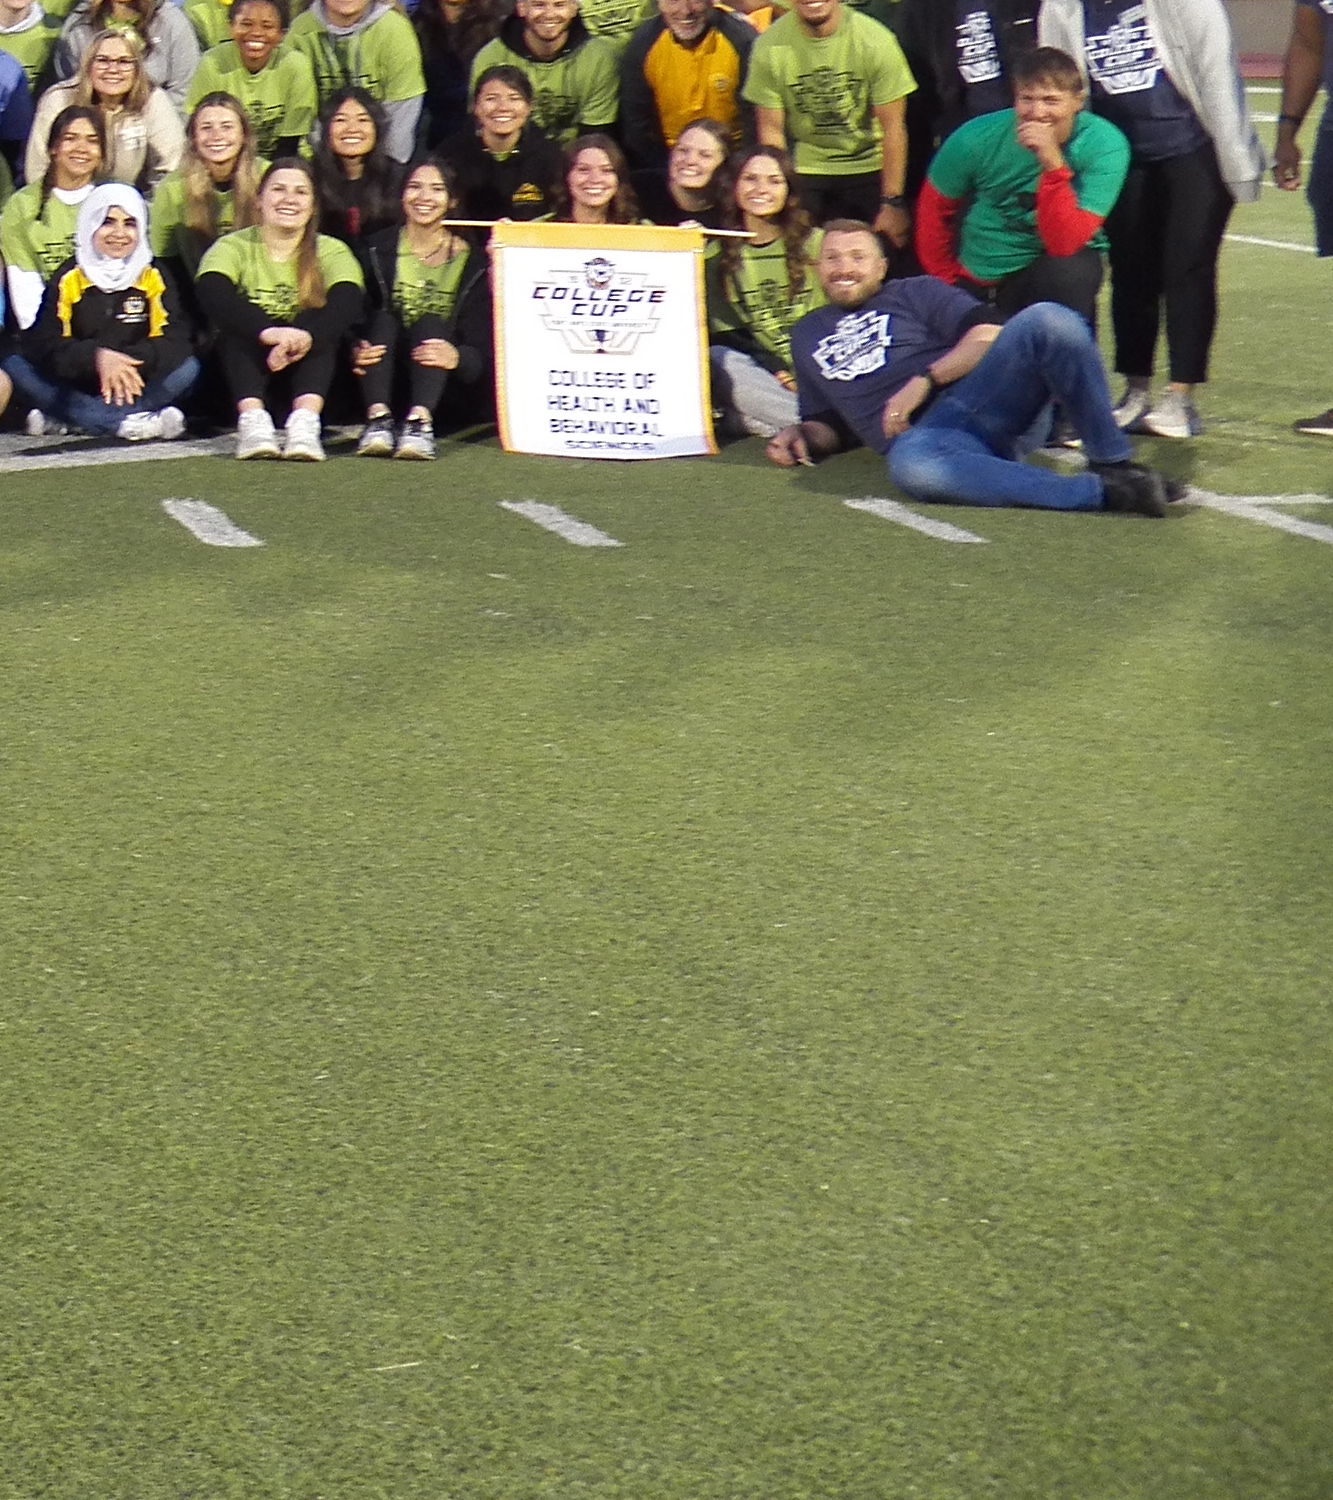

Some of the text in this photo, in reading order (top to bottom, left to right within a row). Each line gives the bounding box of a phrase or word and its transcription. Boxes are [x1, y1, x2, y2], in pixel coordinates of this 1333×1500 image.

[532, 286, 668, 303] COLLEGE
[571, 303, 629, 318] CUP
[549, 370, 656, 389] COLLEGE OF
[547, 395, 661, 414] HEALTH AND
[549, 418, 665, 436] BEHAVIORAL
